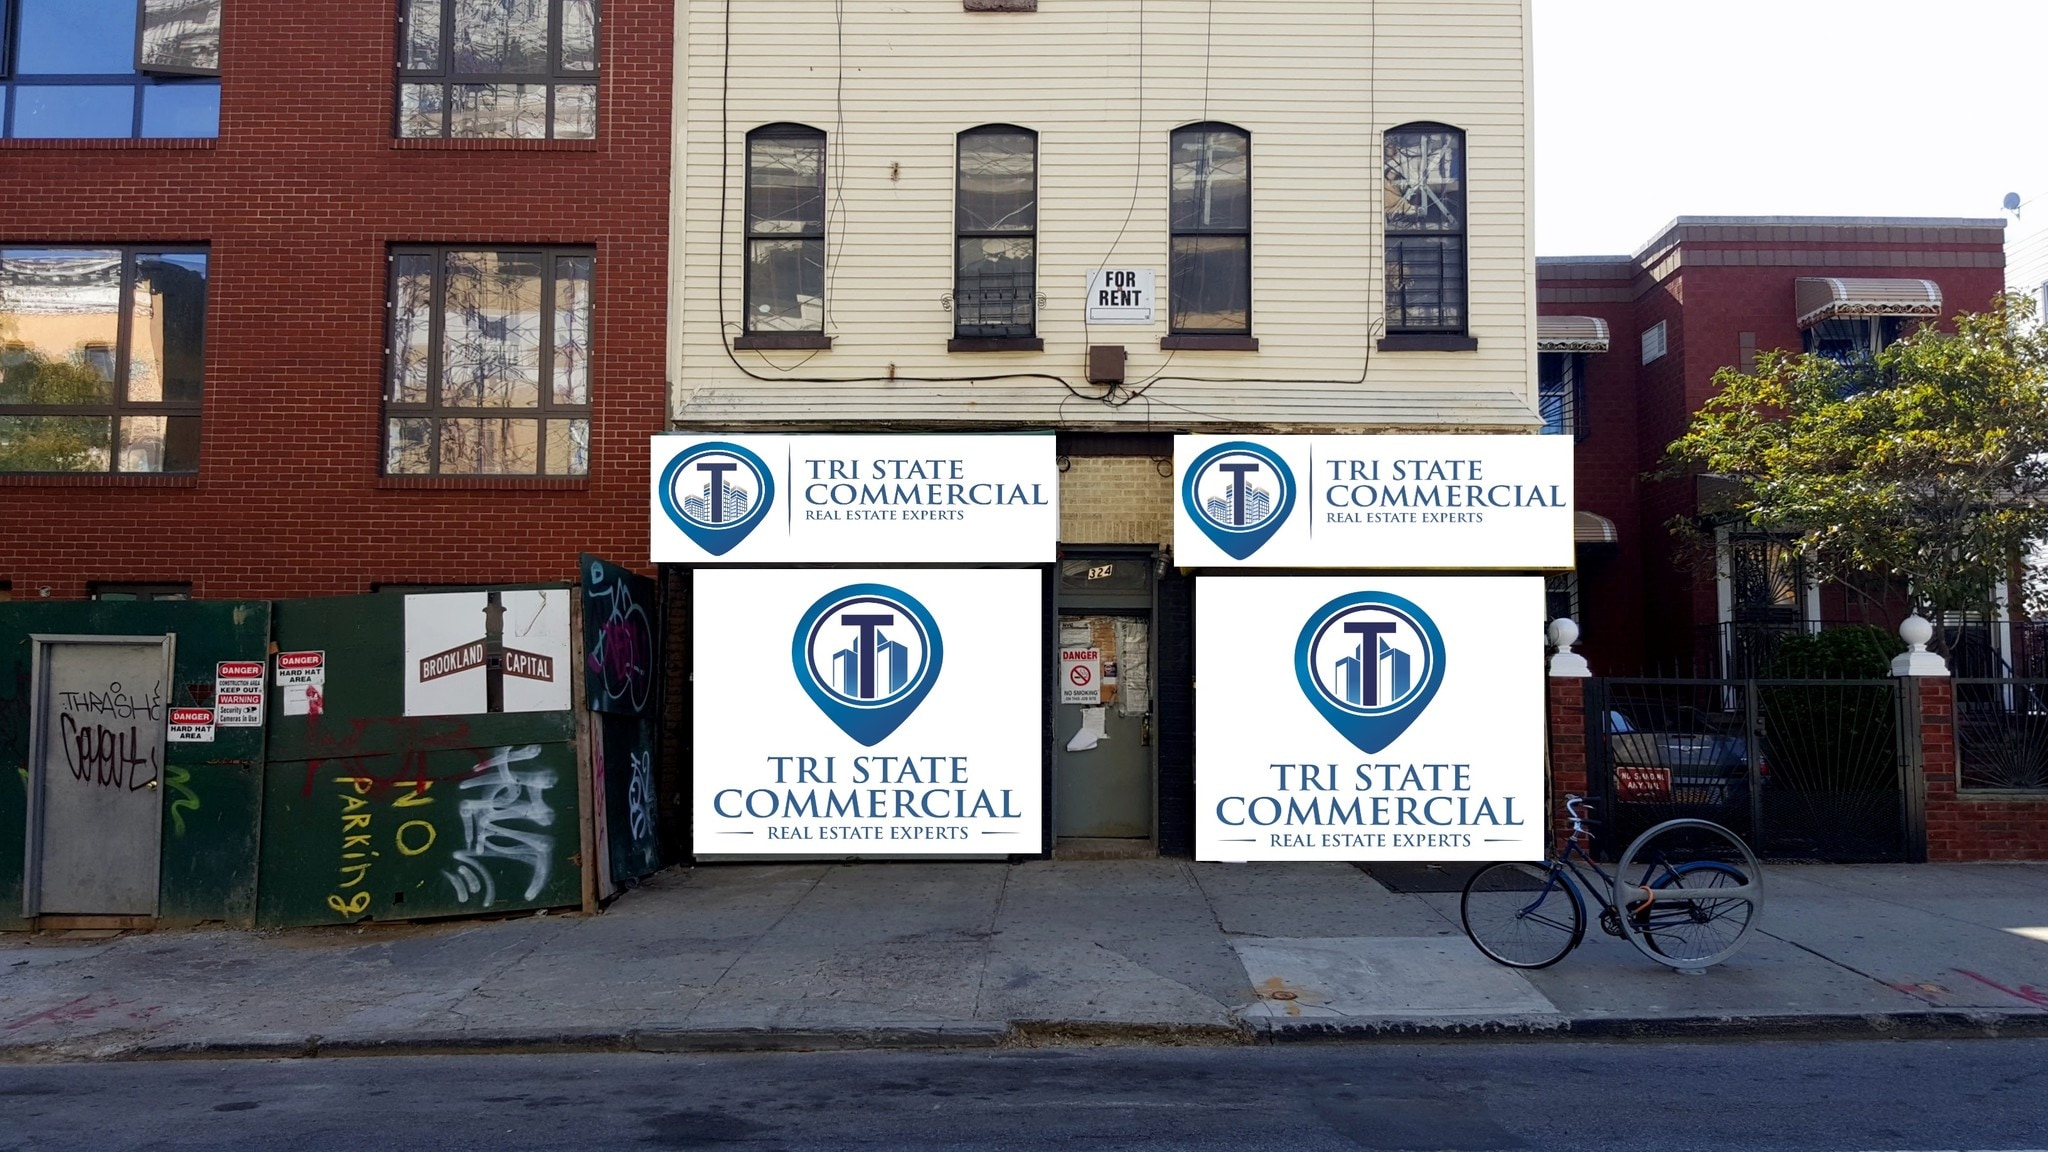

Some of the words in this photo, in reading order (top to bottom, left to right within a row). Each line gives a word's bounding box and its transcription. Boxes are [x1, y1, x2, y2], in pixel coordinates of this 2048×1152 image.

[1105, 271, 1136, 288] FOR
[1099, 290, 1141, 306] RENT
[805, 459, 859, 480] TRI
[872, 459, 964, 480] STATE
[1326, 459, 1380, 481] TRI
[1392, 459, 1483, 481] STATE
[805, 483, 1049, 506] COMMERCIAL
[1326, 484, 1567, 508] COMMERCIAL
[805, 510, 841, 521] REAL
[846, 510, 897, 521] ESTATE
[902, 510, 964, 521] EXPERTS
[1326, 512, 1361, 523] REAL
[1366, 512, 1416, 523] ESTATE
[1422, 512, 1483, 523] EXPERTS
[1089, 564, 1112, 579] 324
[282, 656, 319, 665] DANGER
[423, 644, 483, 679] BROOKLAND
[506, 652, 551, 678] CAPITAL
[1063, 651, 1098, 660] DANGER
[173, 713, 210, 721] DANGER
[220, 706, 242, 714] Security
[766, 756, 837, 784] TRI
[852, 755, 969, 784] STATE
[1269, 763, 1339, 792] TRI
[1355, 763, 1471, 792] STATE
[713, 788, 1022, 819] COMMERCIAL
[1216, 796, 1525, 826] COMMERCIAL
[392, 780, 437, 856] NO
[767, 826, 814, 840] REAL
[819, 826, 884, 840] ESTATE
[890, 826, 969, 840] EXPERTS
[1270, 833, 1316, 848] REAL
[1322, 833, 1386, 848] ESTATE
[1393, 833, 1471, 848] EXPERTS
